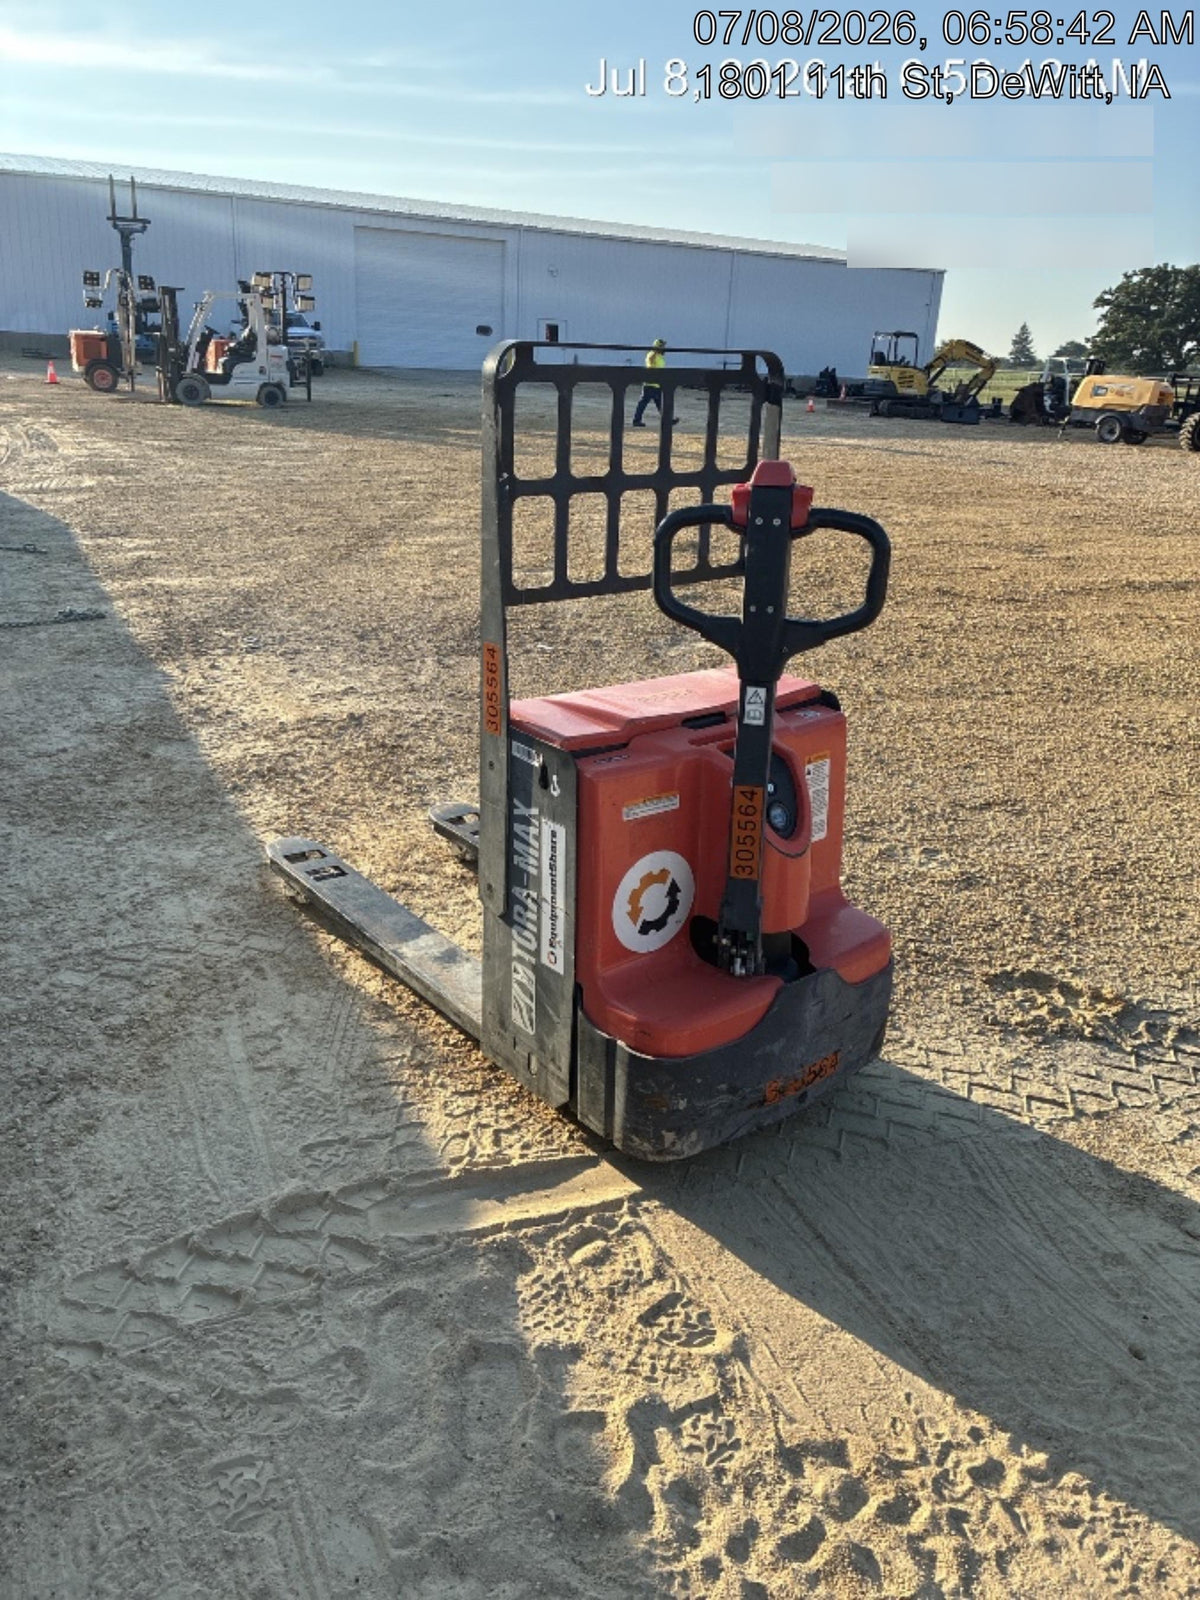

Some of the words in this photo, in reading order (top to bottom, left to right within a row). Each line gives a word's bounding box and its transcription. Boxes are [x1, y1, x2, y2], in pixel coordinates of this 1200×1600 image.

[485, 646, 500, 733] 305564
[511, 797, 540, 966] TORA-MAX
[735, 787, 759, 877] 305564
[548, 829, 558, 950] EquipmentShare
